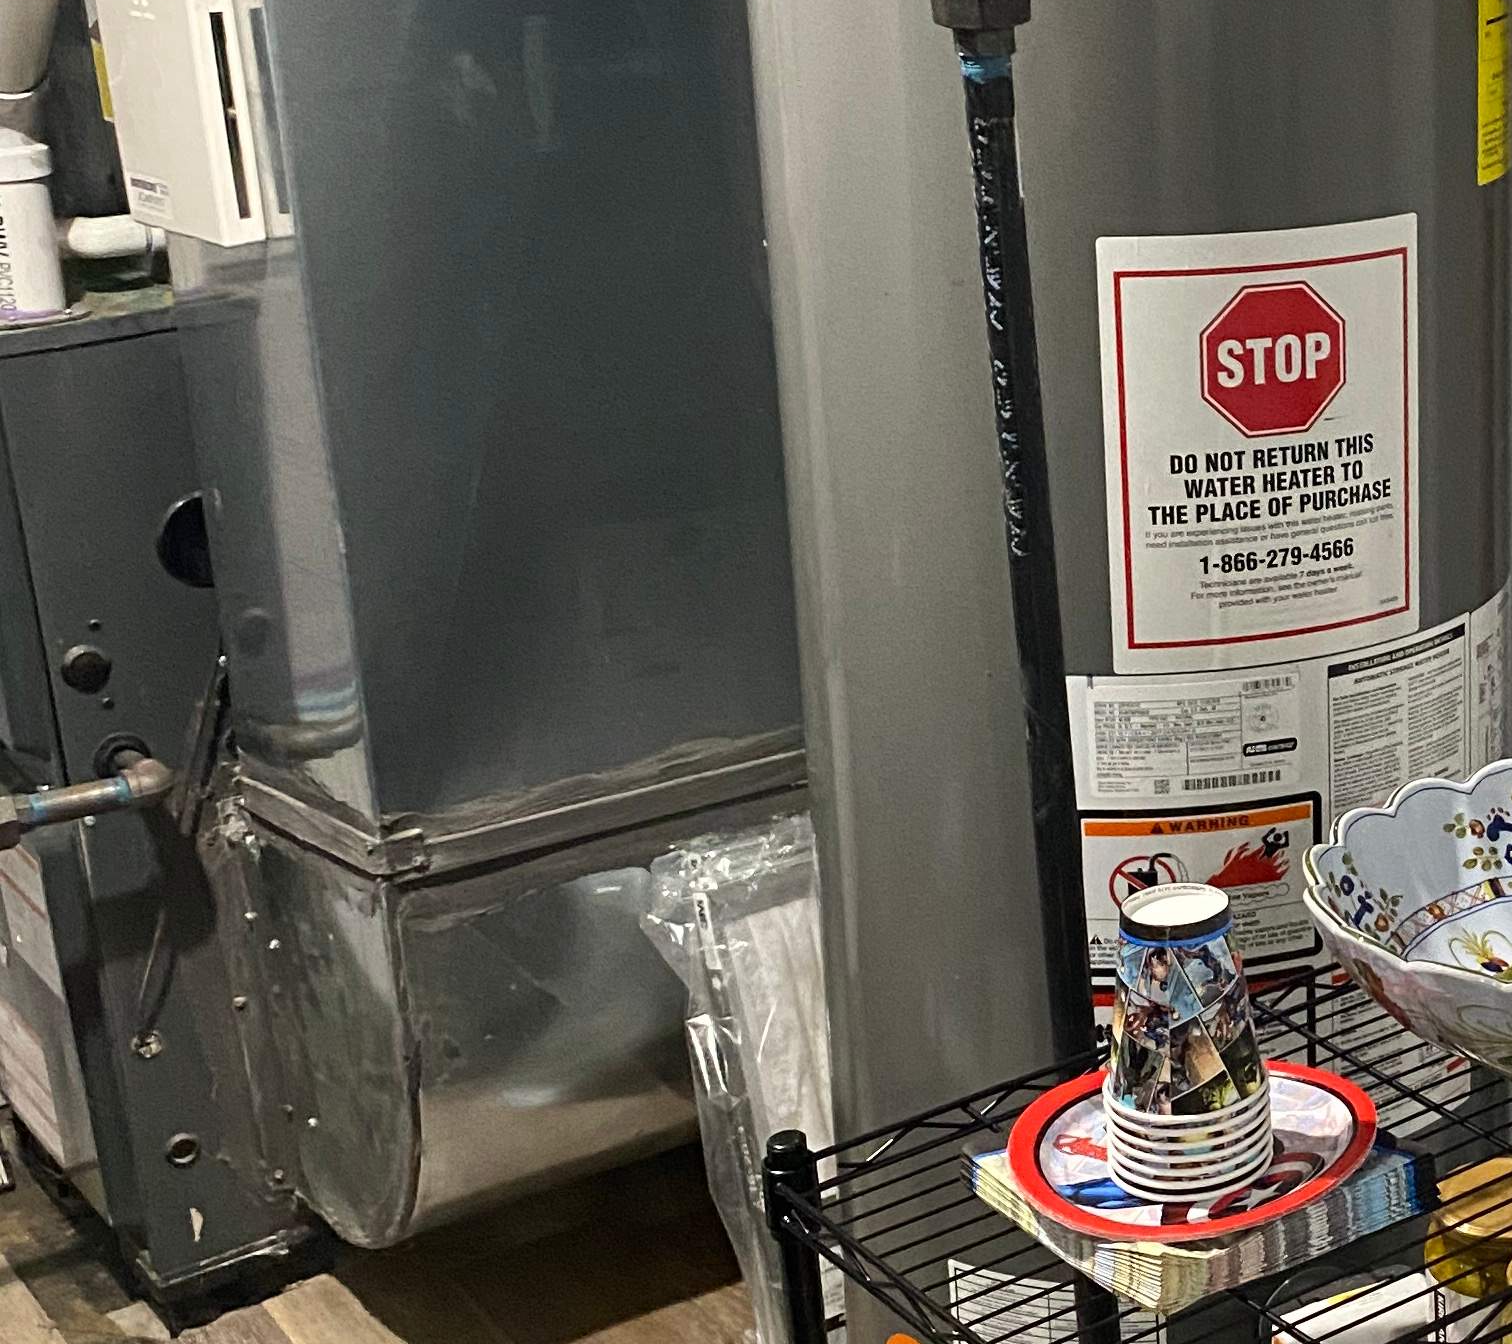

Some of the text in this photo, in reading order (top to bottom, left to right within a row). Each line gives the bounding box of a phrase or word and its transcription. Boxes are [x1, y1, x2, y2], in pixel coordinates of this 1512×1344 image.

[1217, 332, 1331, 388] STOP
[1170, 433, 1374, 475] DO NOT RETURN THIS
[1184, 460, 1363, 499] WATER HEATER TO
[1148, 478, 1391, 525] THE PLACE OF PURCHASE
[1199, 537, 1354, 575] 1-866-279-4566
[1169, 814, 1249, 832] WARNING
